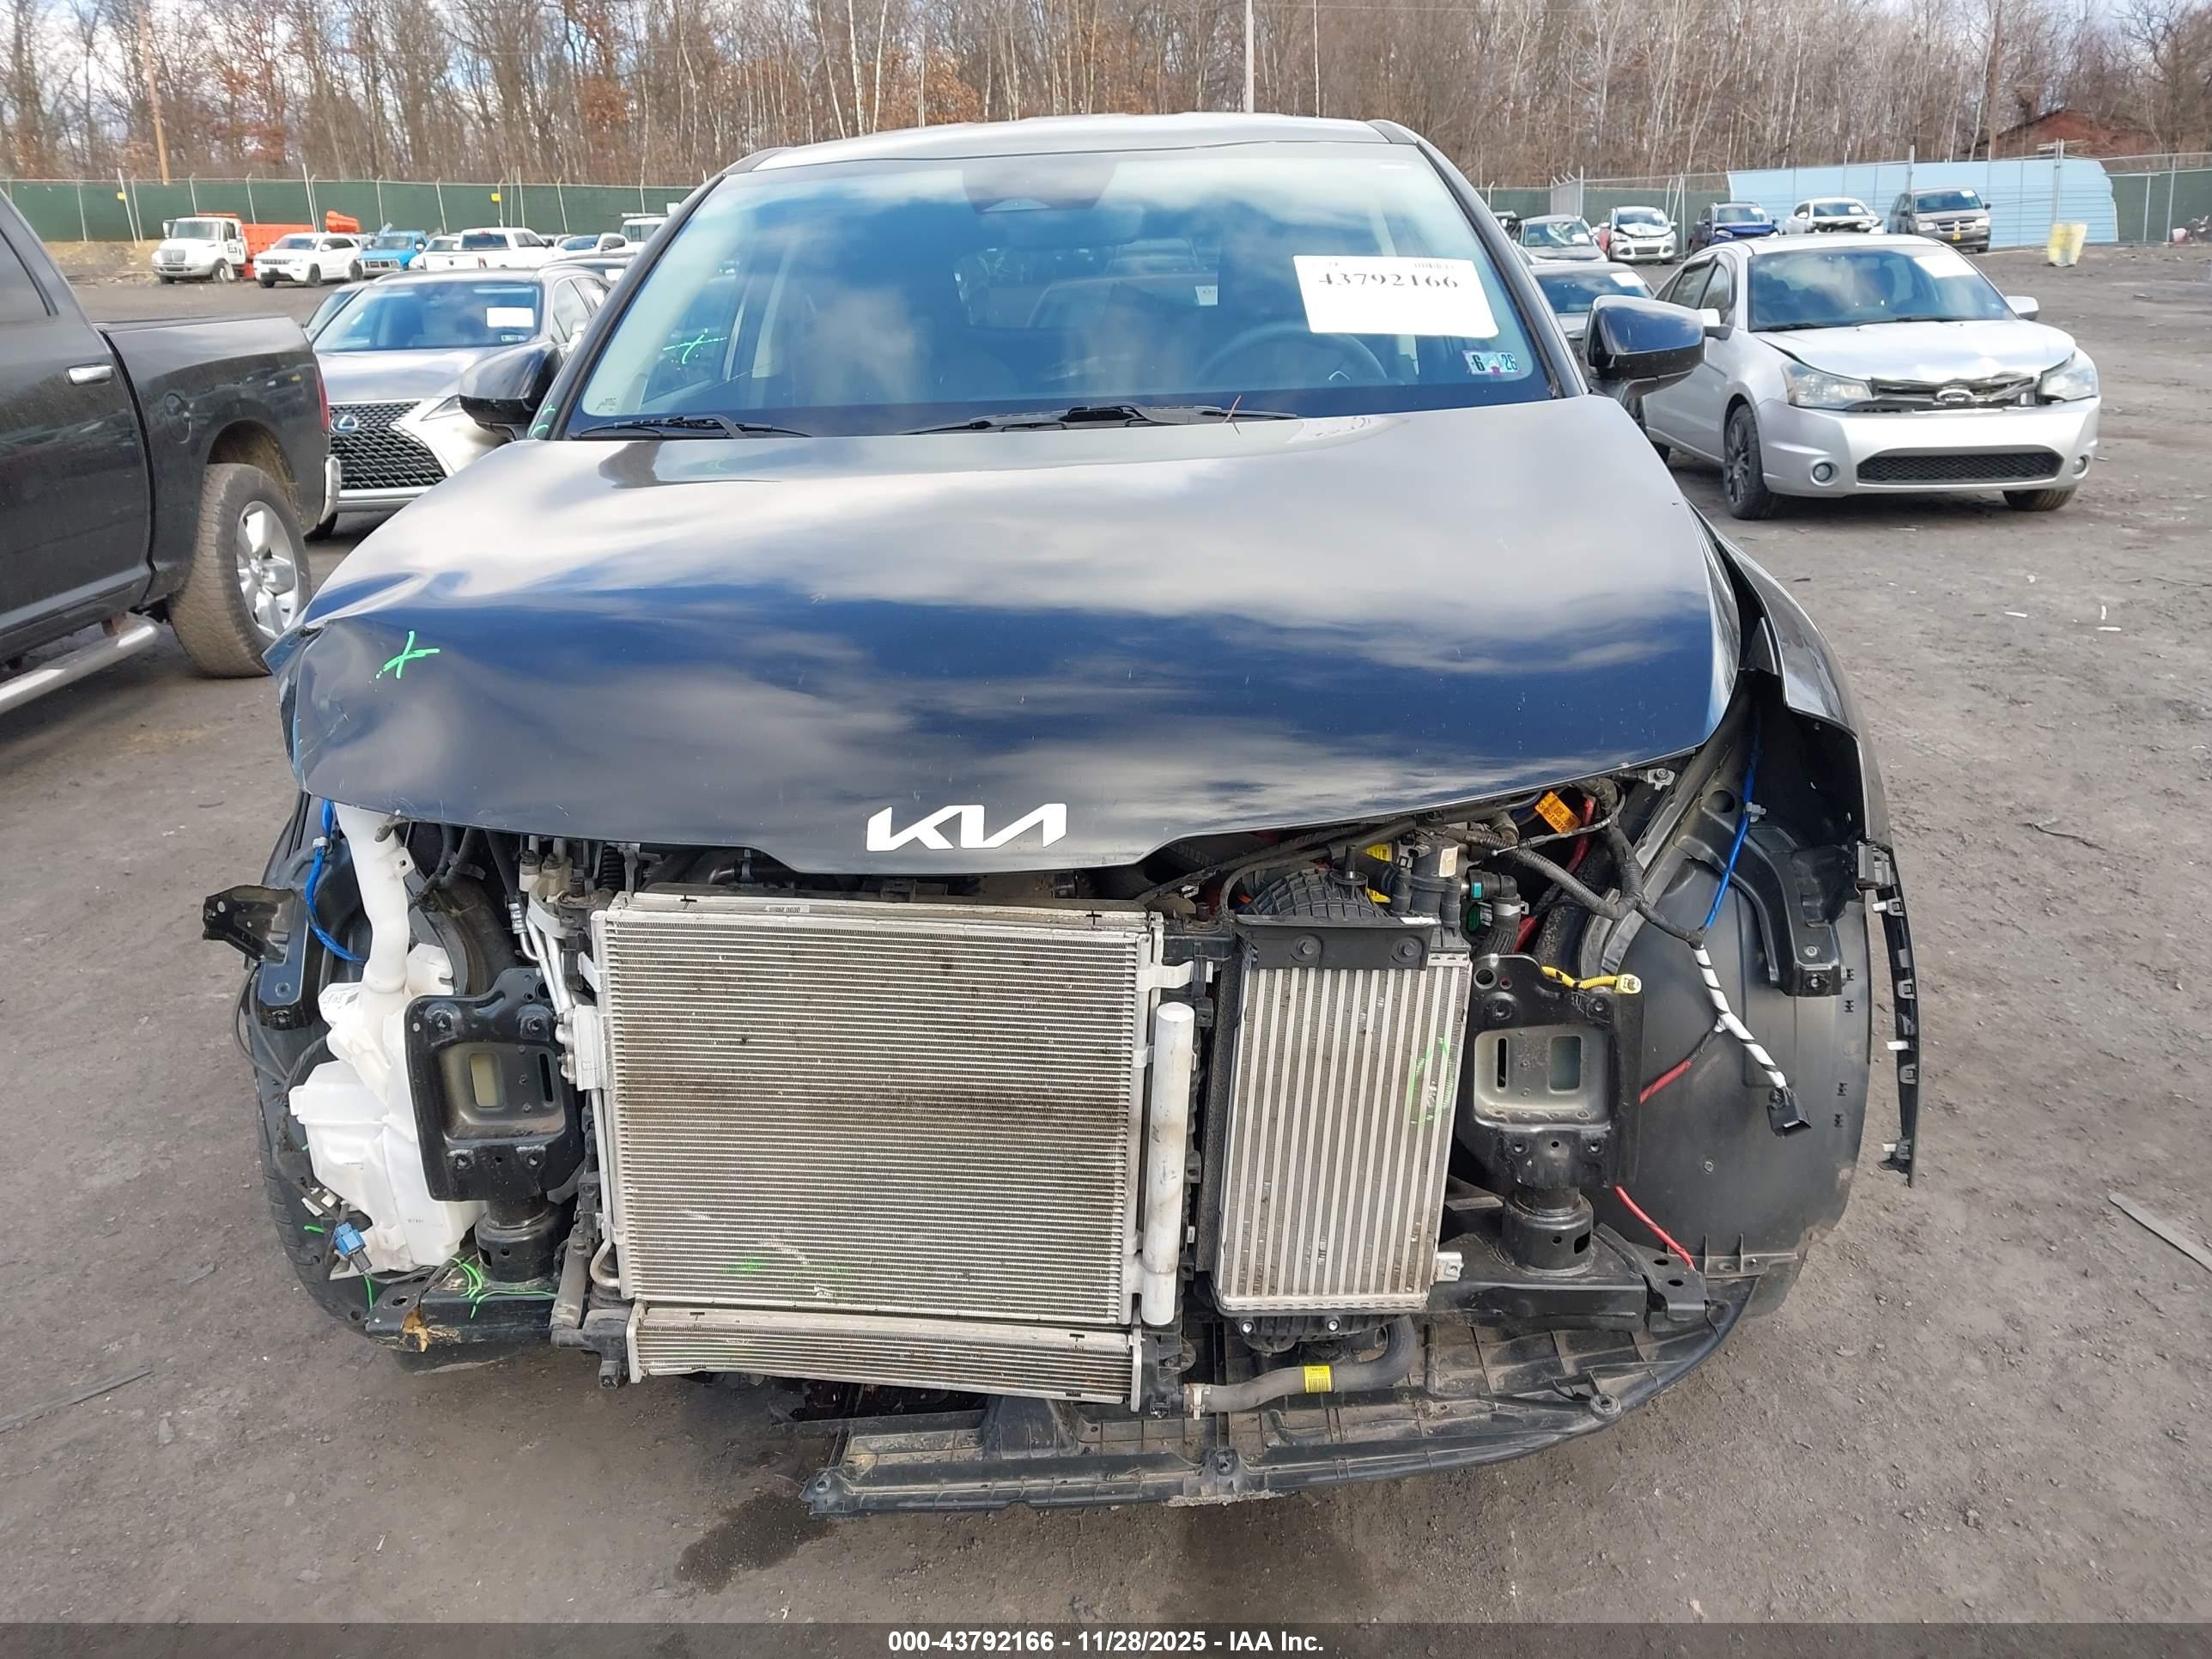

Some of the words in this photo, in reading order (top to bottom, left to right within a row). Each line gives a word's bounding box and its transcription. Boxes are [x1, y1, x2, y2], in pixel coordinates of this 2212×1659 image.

[1318, 272, 1458, 288] 43792166
[1472, 354, 1486, 372] 6
[1500, 353, 1518, 371] 26
[866, 803, 1067, 853] KIA
